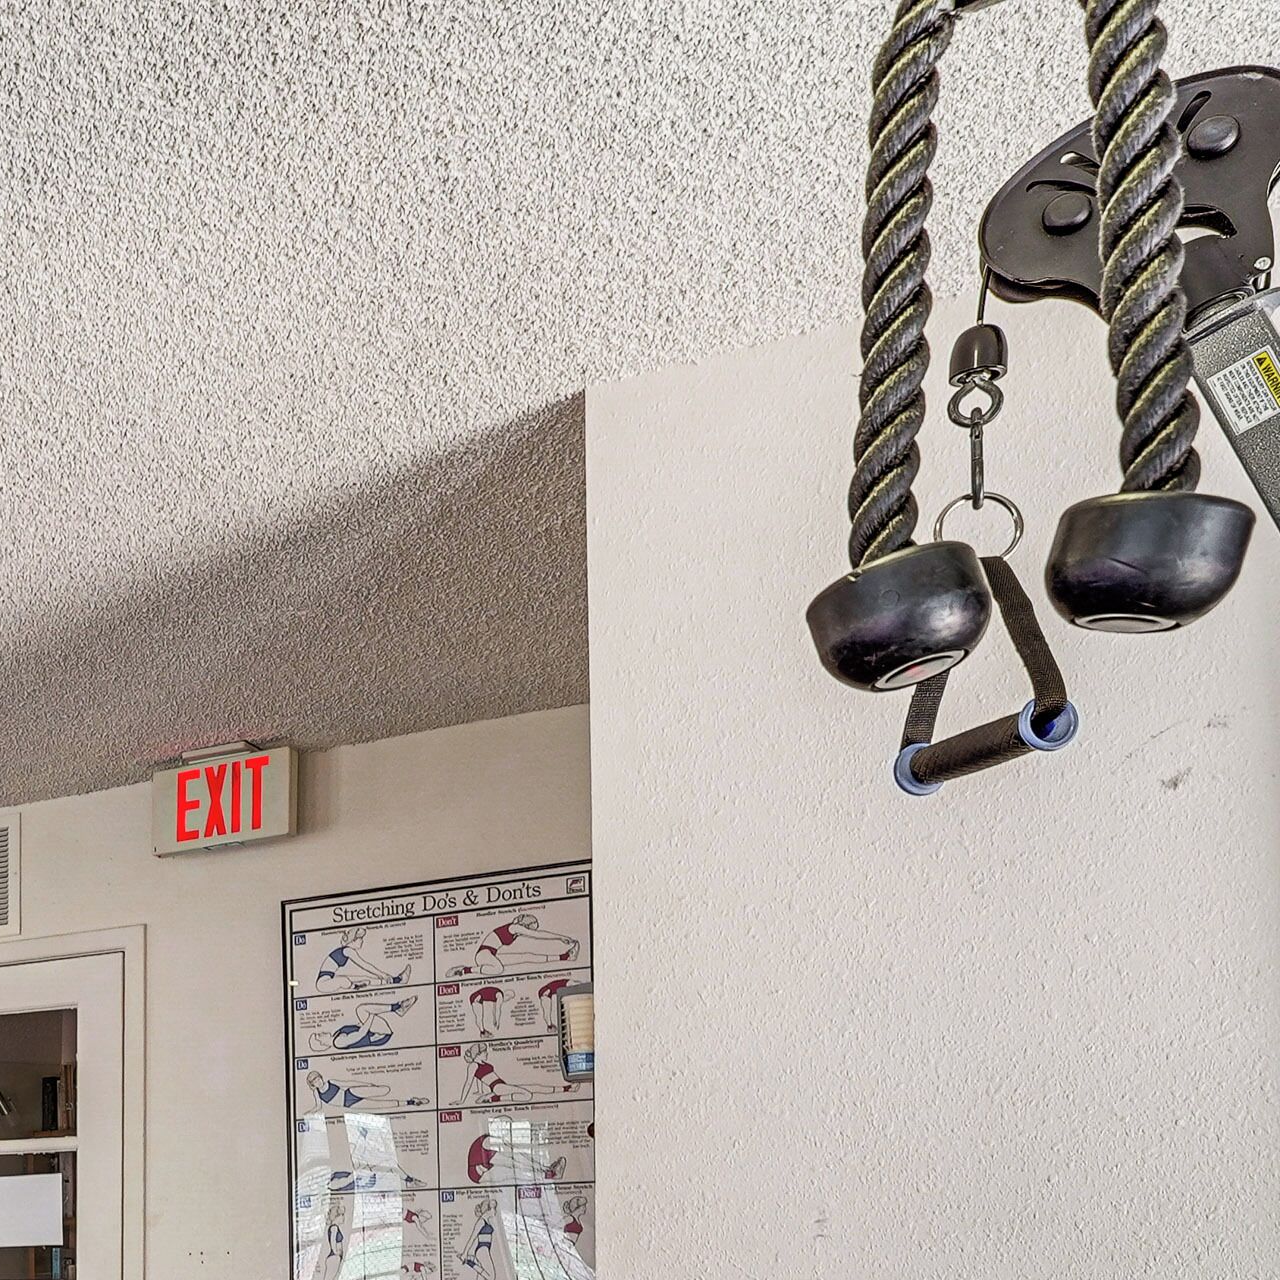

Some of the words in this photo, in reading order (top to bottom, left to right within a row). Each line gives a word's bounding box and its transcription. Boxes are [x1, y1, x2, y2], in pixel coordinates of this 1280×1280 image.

[177, 756, 269, 842] EXIT
[333, 899, 415, 923] Stretching
[422, 893, 457, 912] Do's
[463, 889, 479, 906] &
[486, 882, 541, 904] Don'ts
[438, 917, 458, 927] Don't
[296, 936, 305, 945] Do
[439, 986, 458, 995] Don't
[297, 1001, 307, 1010] Do
[441, 1048, 460, 1057] Don't
[298, 1061, 308, 1070] Do
[442, 1113, 461, 1122] Don't
[443, 1193, 454, 1202] Do
